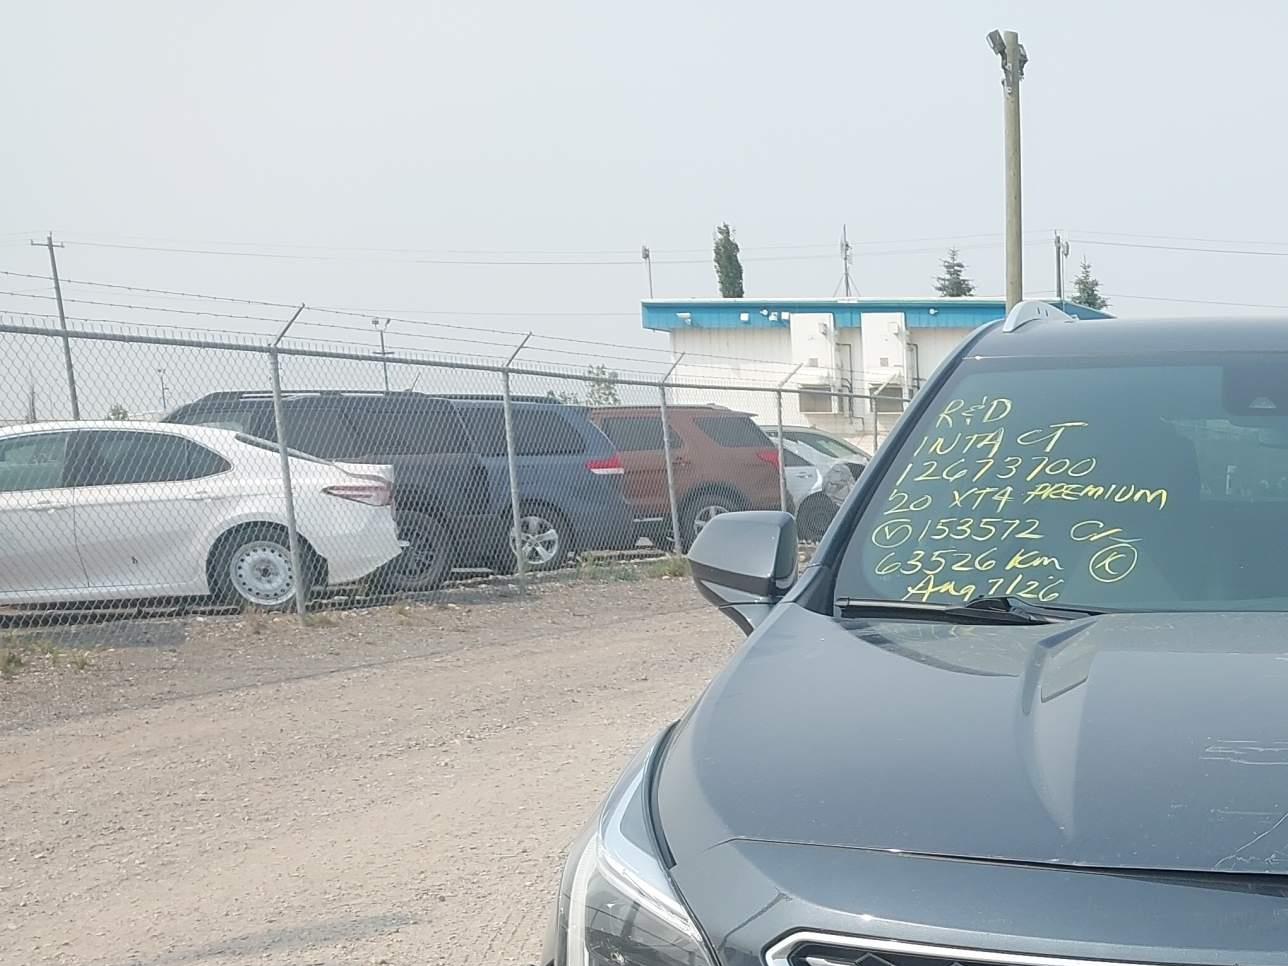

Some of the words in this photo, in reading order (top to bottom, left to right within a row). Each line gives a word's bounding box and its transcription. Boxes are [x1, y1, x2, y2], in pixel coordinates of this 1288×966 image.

[895, 456, 1097, 487] 12673700
[882, 488, 933, 516] 20
[948, 485, 1018, 514] XT4
[1022, 481, 1169, 511] PREMIUM
[917, 518, 1046, 542] 153572
[873, 547, 998, 576] 63526
